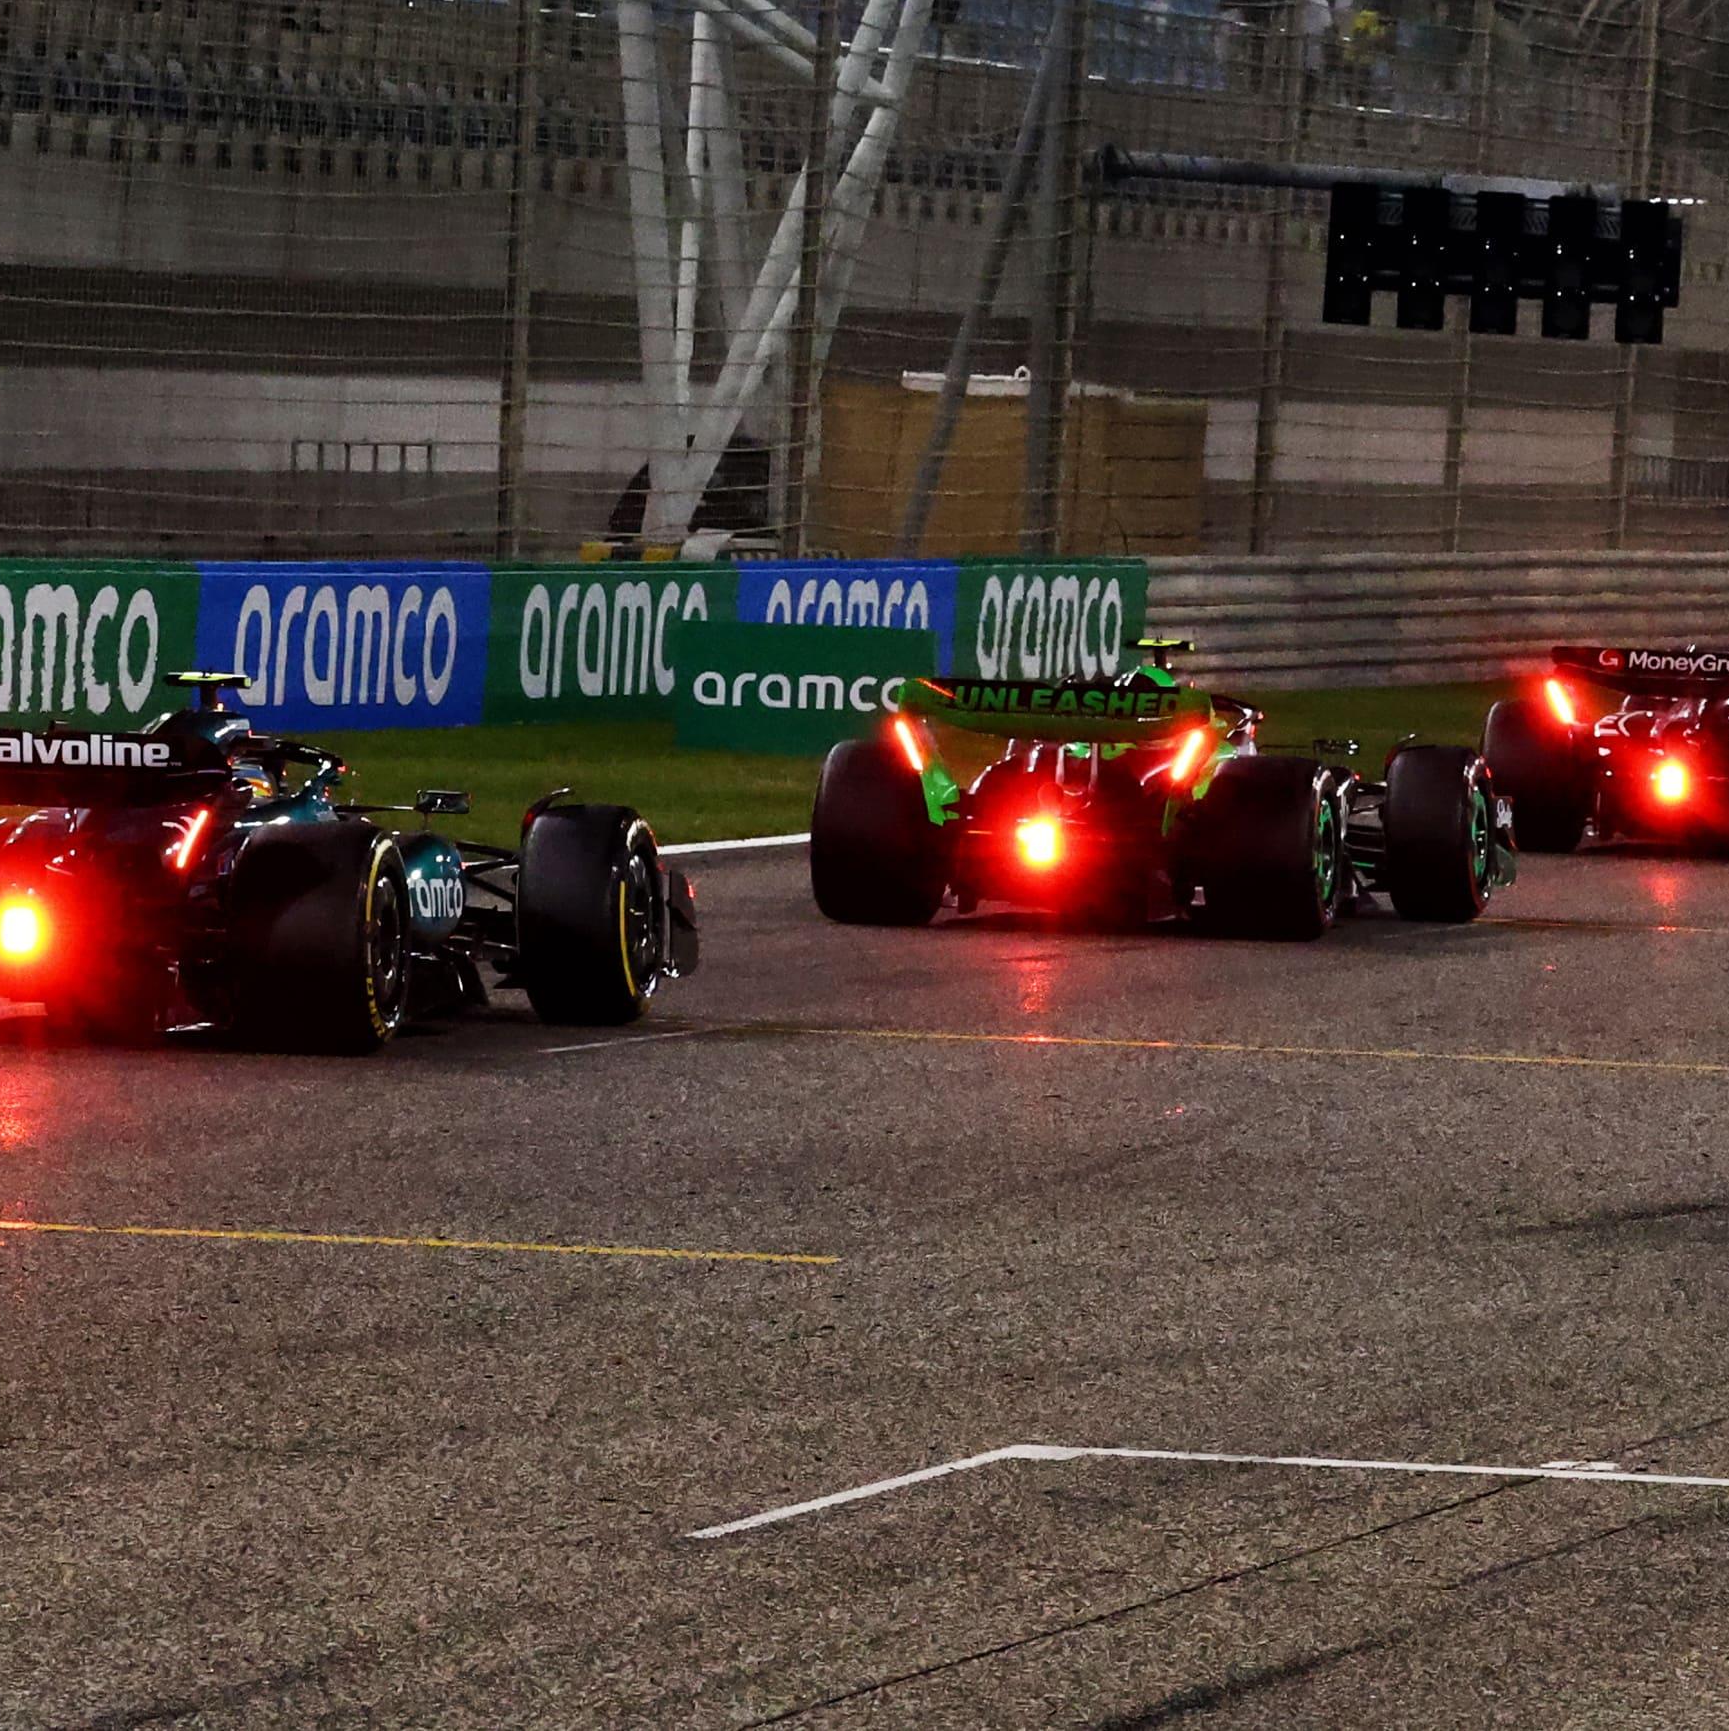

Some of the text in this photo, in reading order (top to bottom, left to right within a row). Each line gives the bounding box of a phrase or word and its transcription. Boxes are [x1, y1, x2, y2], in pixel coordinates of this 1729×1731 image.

[234, 584, 458, 707] aramco
[976, 574, 1123, 680] aramco
[693, 670, 907, 712] aramco
[406, 877, 464, 919] ramco
